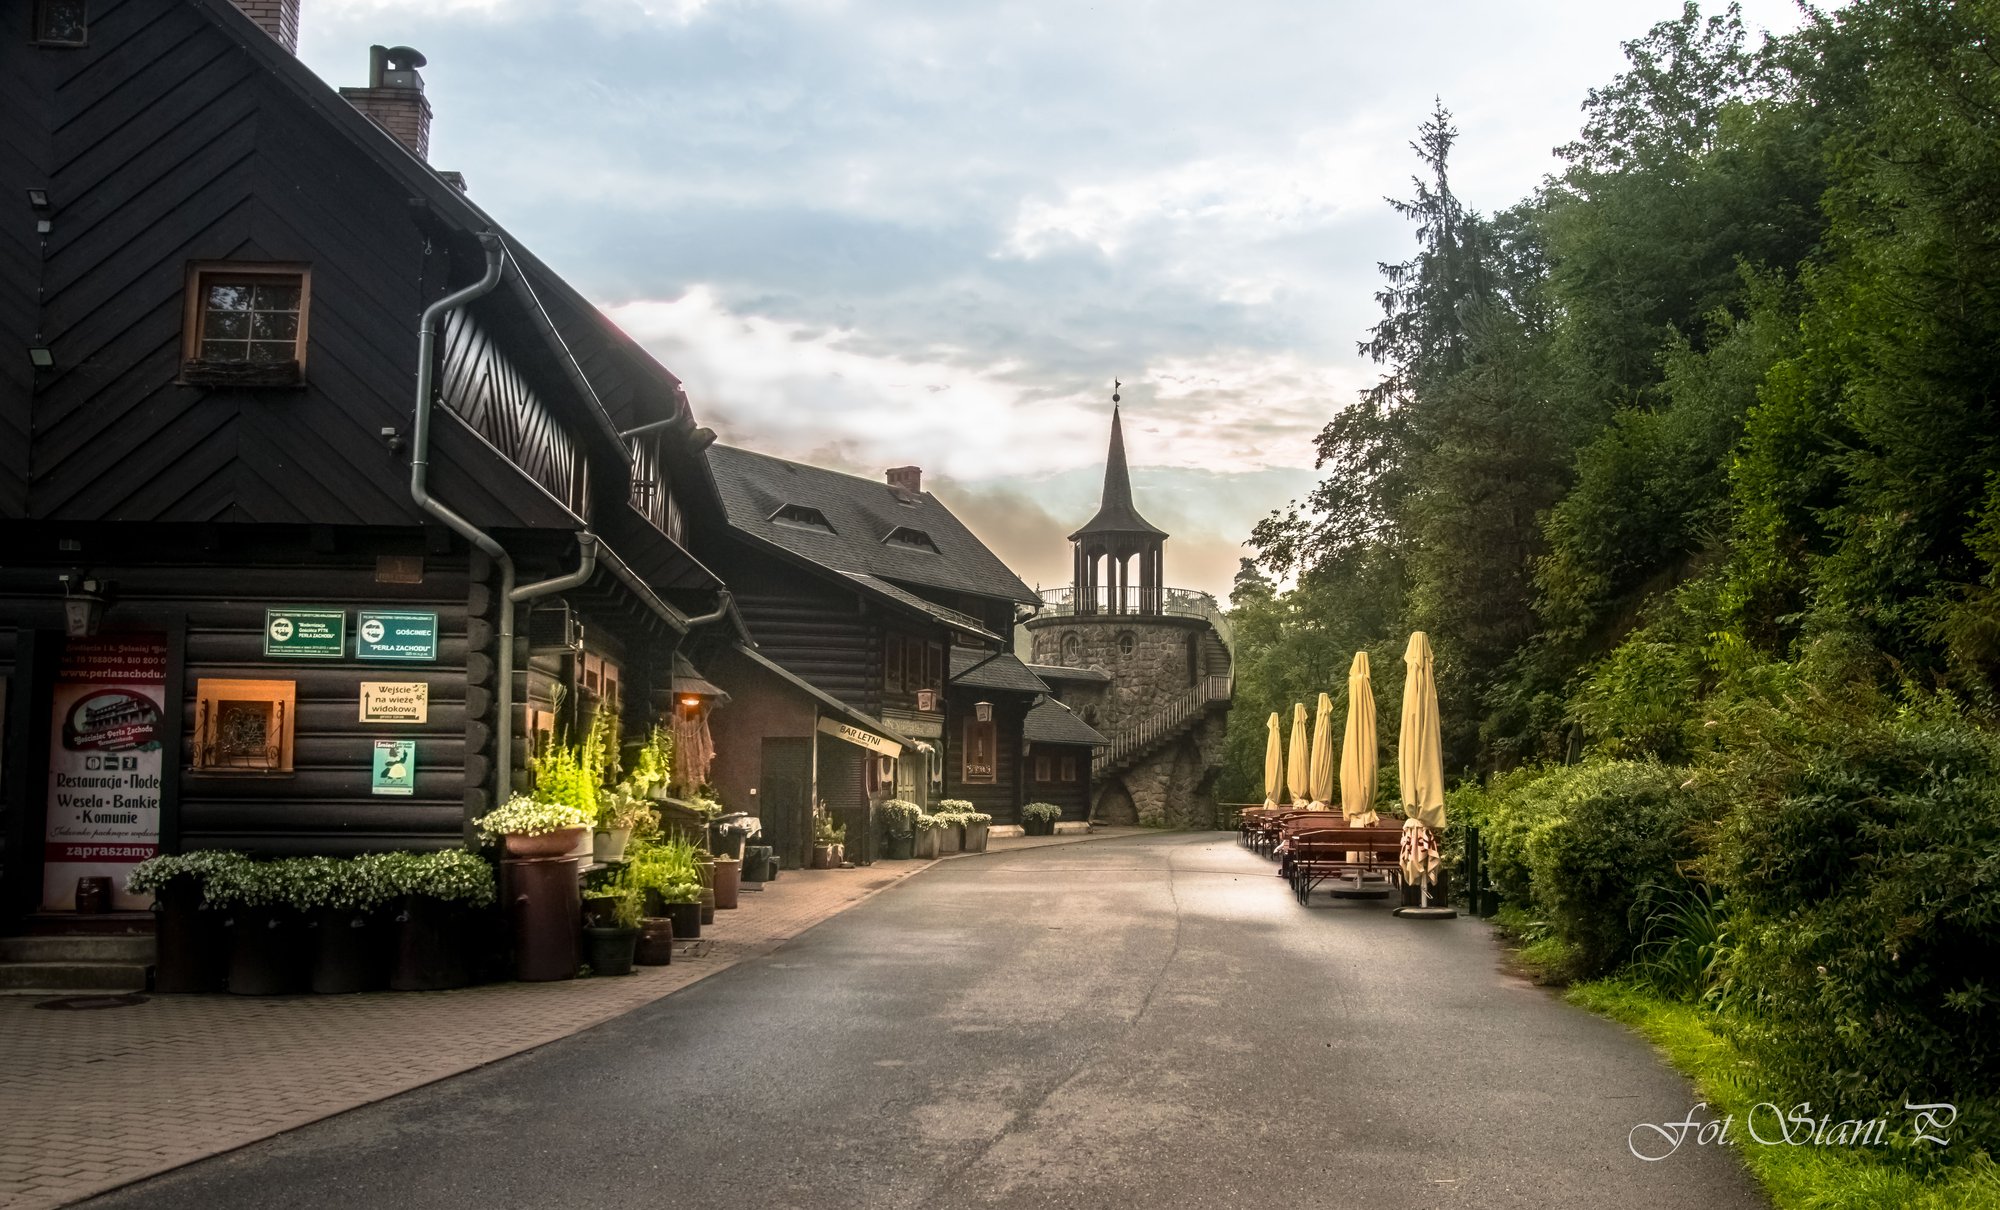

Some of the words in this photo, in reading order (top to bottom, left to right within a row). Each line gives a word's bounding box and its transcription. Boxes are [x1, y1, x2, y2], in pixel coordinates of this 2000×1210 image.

[395, 628, 432, 636] GOŚCINIEC
[378, 686, 412, 695] Wejście
[389, 696, 414, 704] wieżę
[371, 705, 417, 713] widokową
[840, 725, 857, 737] BAR
[857, 731, 881, 746] LETNI
[57, 773, 122, 790] Restauracja
[130, 774, 162, 789] Nocle
[57, 794, 103, 808] Wesela
[113, 794, 161, 808] Bankie
[82, 809, 138, 824] Komunie
[66, 846, 154, 859] zapraszamy
